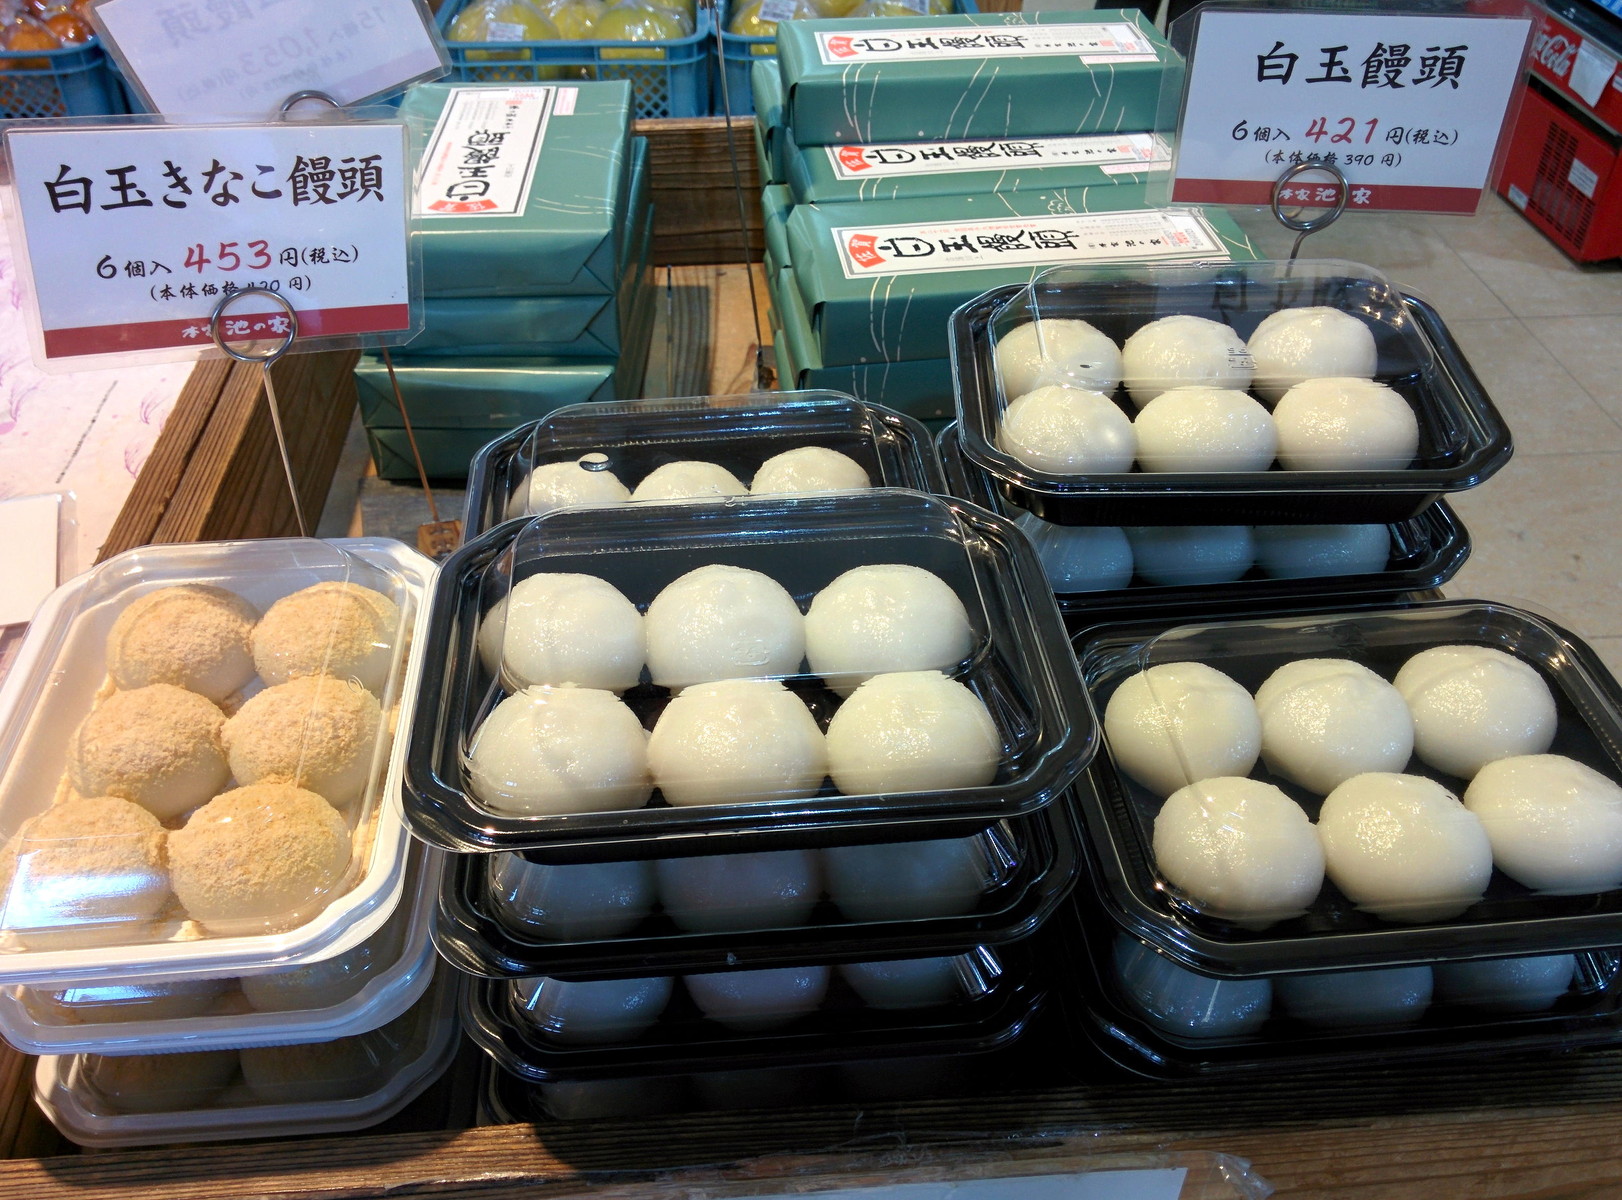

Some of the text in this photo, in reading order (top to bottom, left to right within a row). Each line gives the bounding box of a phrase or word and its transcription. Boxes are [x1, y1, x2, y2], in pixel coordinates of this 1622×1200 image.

[853, 34, 1029, 52] 白玉饅頭
[1256, 40, 1469, 89] 白玉饅頭
[1304, 116, 1379, 144] 421
[445, 129, 511, 201] 白玉饅頭
[865, 142, 1044, 164] 白玉饅頭
[44, 154, 385, 215] 白玉きなこ饅頭
[1278, 187, 1372, 204] 本家池家
[183, 239, 272, 273] 453
[877, 229, 1080, 258] 白玉饅頭
